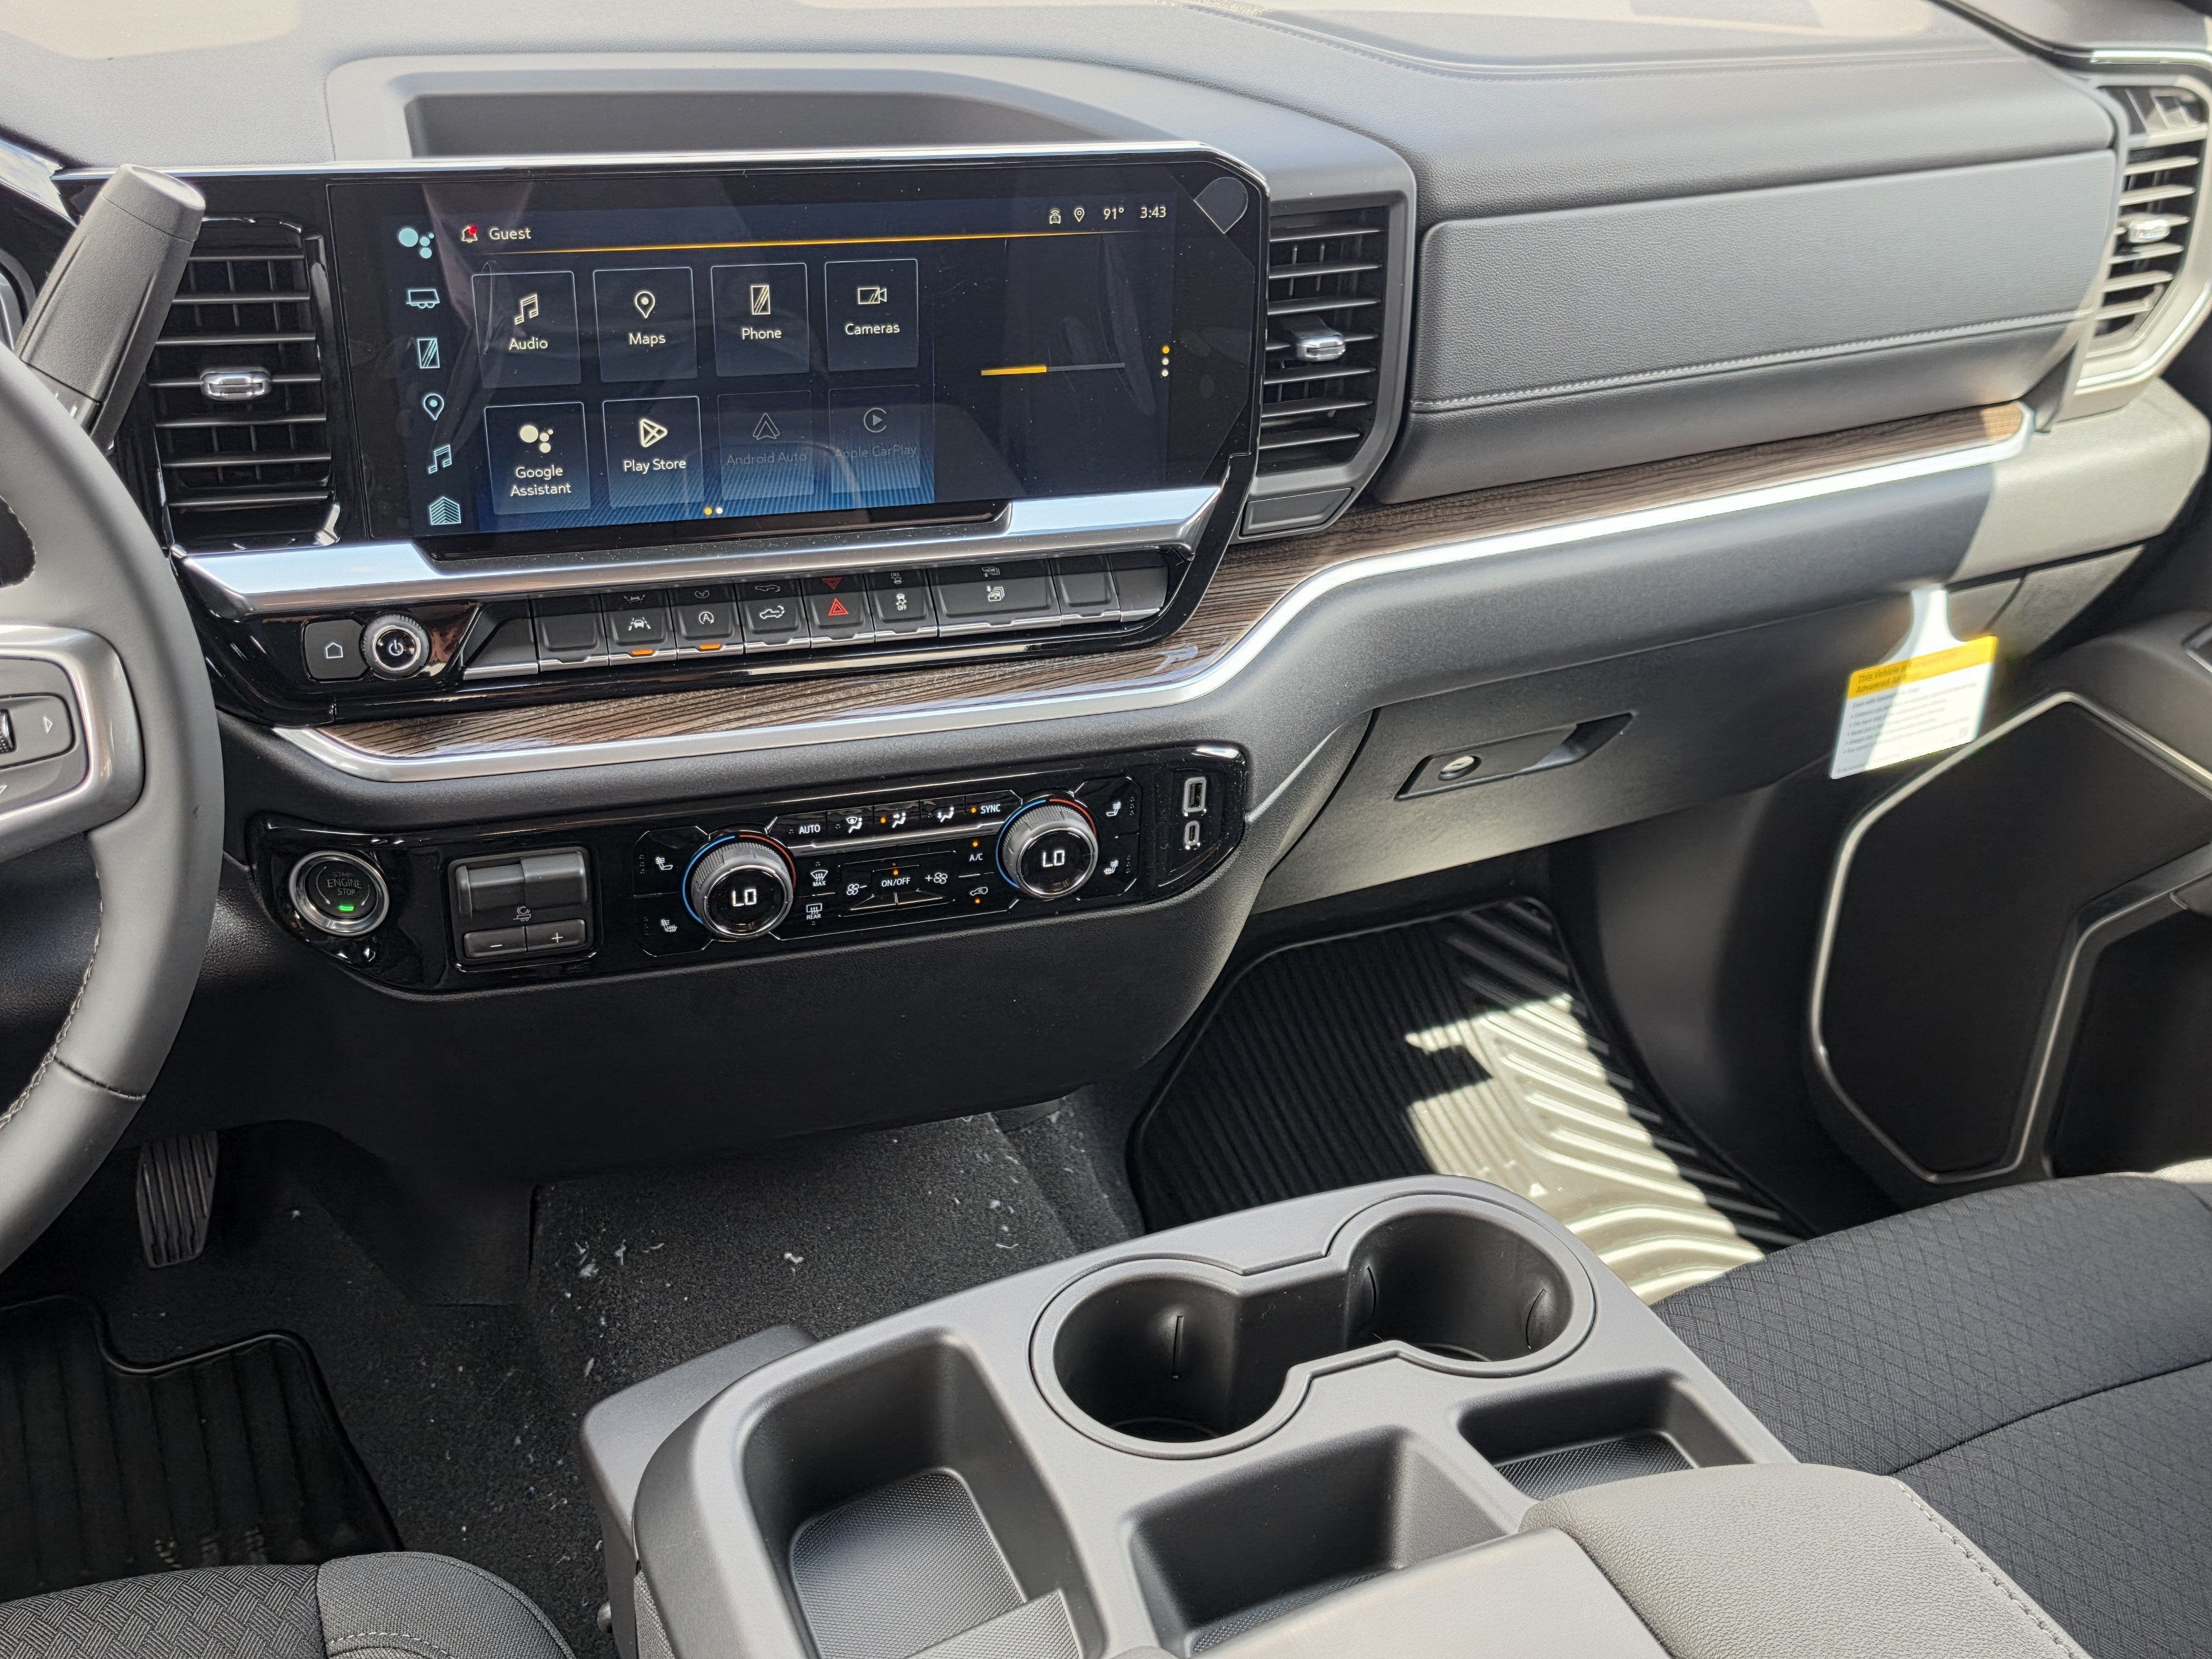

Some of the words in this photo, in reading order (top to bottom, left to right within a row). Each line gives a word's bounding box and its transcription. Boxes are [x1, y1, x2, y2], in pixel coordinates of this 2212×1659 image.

[1140, 207, 1167, 218] 3:43
[489, 228, 531, 241] Guest
[742, 328, 782, 341] Phone
[845, 324, 900, 336] Cameras
[509, 337, 549, 351] Audio
[629, 333, 666, 347] Maps
[834, 446, 868, 459] Apple
[873, 445, 917, 458] CarPlay
[727, 452, 775, 466] Android
[778, 452, 807, 462] Auto
[624, 459, 650, 474] Play
[653, 458, 686, 470] Store
[515, 465, 564, 481] Google
[510, 483, 572, 497] Assistant
[703, 613, 711, 622] A
[980, 805, 1001, 814] SYNC
[799, 824, 821, 834] AUTO
[969, 853, 983, 862] A/C
[1042, 850, 1065, 868] LO
[327, 879, 362, 889] ENGINE
[881, 877, 911, 888] ON/OFF
[732, 889, 757, 907] LO
